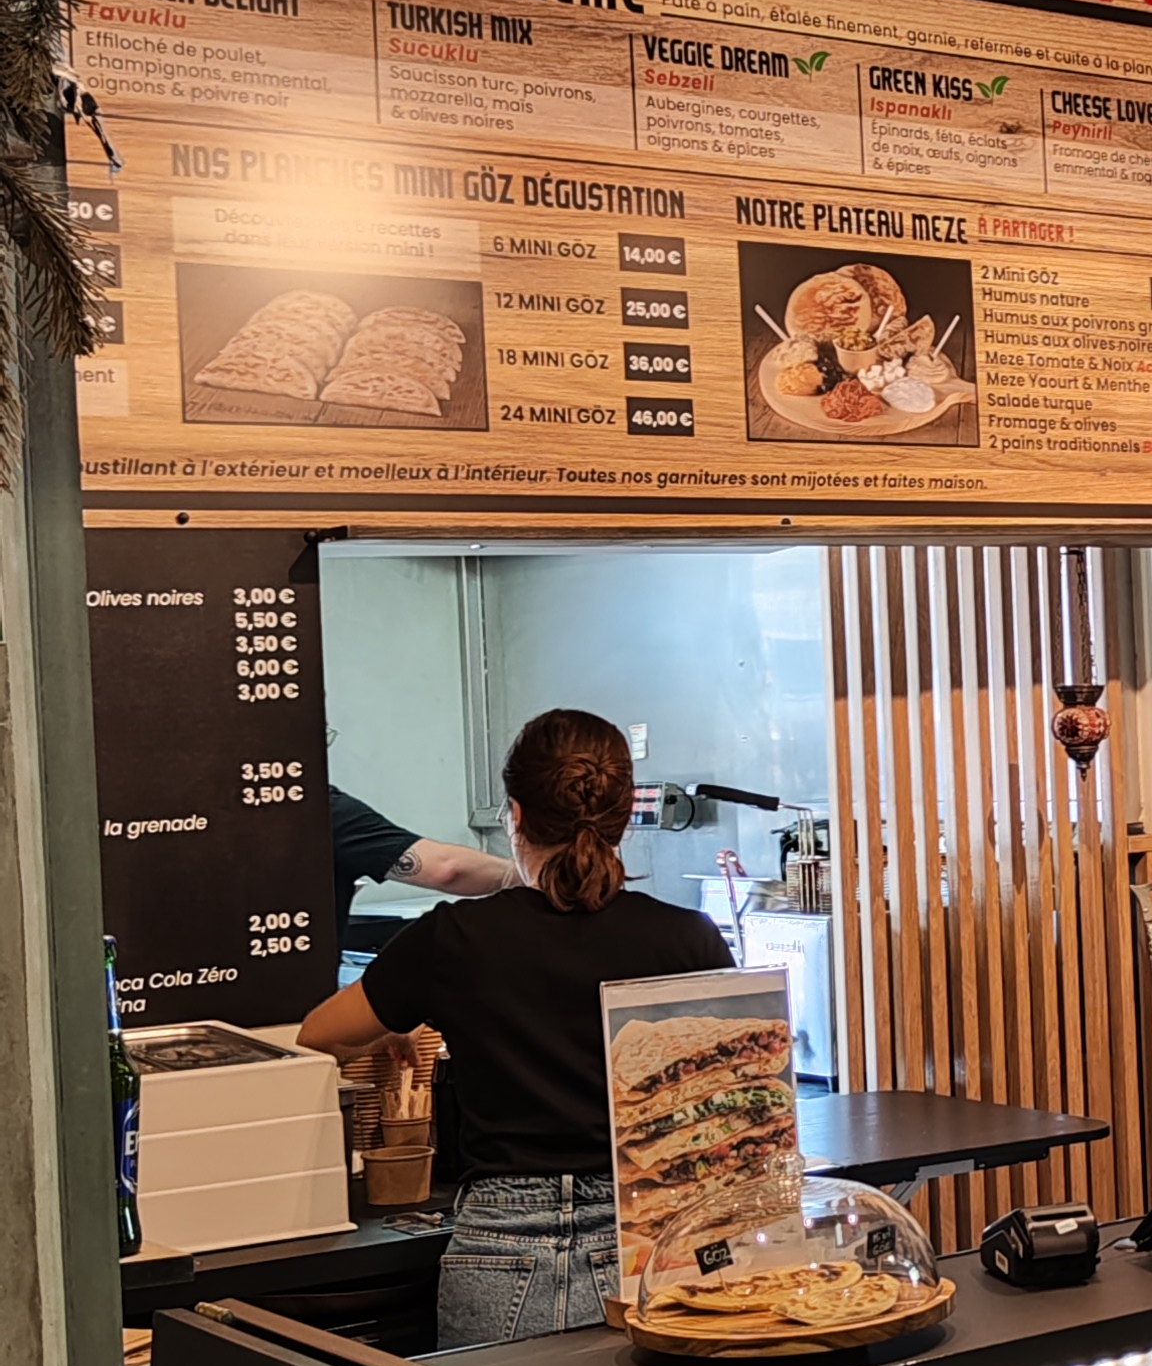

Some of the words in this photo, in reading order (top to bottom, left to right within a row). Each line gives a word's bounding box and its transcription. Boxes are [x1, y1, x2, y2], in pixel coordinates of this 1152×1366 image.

[86, 1, 187, 29] Tavuklu
[387, 1, 483, 40] TURKISH
[491, 15, 533, 45] MIX
[86, 30, 168, 55] Effiloché
[173, 41, 197, 57] de
[723, 2, 765, 23] pain,
[770, 6, 822, 28] étalée
[827, 15, 901, 40] finement,
[965, 35, 1032, 59] refermée
[1054, 48, 1090, 66] cuite
[388, 38, 479, 63] Sucuklu
[643, 34, 715, 69] VEGGIE
[721, 44, 789, 78] DREAM
[88, 76, 166, 96] oignons
[191, 85, 256, 104] poivre
[390, 65, 478, 89] Saucisson
[523, 82, 596, 104] poivrons,
[644, 68, 715, 92] Sebzeli
[869, 65, 927, 96] GREEN
[932, 74, 973, 102] KISS
[646, 96, 736, 120] Aubergines,
[739, 106, 821, 131] courgettes,
[1051, 90, 1112, 120] CHEESE
[409, 107, 458, 126] olives
[463, 113, 514, 131] noires
[1052, 120, 1113, 142] Peynirli
[647, 134, 708, 151] oignons
[728, 140, 776, 159] épices
[968, 132, 1007, 151] éclats
[966, 150, 1018, 168] oignons
[1052, 143, 1108, 165] Fromage
[887, 158, 932, 176] épices
[1054, 162, 1117, 179] emmental
[172, 143, 230, 180] NOS
[397, 163, 454, 200] MINI
[463, 168, 515, 206] GÖZ
[524, 169, 685, 220] DÉGUSTATION
[736, 195, 806, 231] NOTRE
[813, 203, 904, 239] PLATEAU
[912, 214, 968, 244] MEZE
[993, 217, 1065, 242] PARTAGER
[510, 237, 552, 257] MINI
[557, 239, 597, 260] GÖZ
[518, 295, 561, 313] MINI
[565, 293, 606, 315] GÖZ
[982, 288, 1037, 304] Humus
[1040, 293, 1089, 308] nature
[983, 309, 1037, 325] Humus
[1072, 315, 1135, 333] poivrons
[984, 330, 1038, 346] Humus
[1073, 334, 1116, 350] olives
[523, 350, 565, 368] MINI
[570, 350, 610, 371] GÖZ
[985, 351, 1024, 366] Meze
[1027, 353, 1084, 369] Tomate
[986, 372, 1025, 387] Meze
[1028, 375, 1078, 390] Yaourt
[1096, 378, 1150, 393] Menthe
[500, 404, 525, 422] 24
[529, 405, 573, 424] MINI
[577, 404, 616, 426] GÖZ
[987, 393, 1039, 408] Salade
[1043, 396, 1093, 414] turque
[988, 414, 1056, 434] Fromage
[1074, 416, 1116, 432] olives
[1001, 436, 1043, 453] pains
[1047, 437, 1140, 454] traditionnels
[339, 460, 431, 481] moelleux
[556, 467, 617, 484] Toutes
[621, 471, 653, 485] nos
[657, 469, 747, 489] garnitures
[751, 471, 787, 487] sont
[791, 472, 859, 492] mijotées
[881, 472, 925, 490] faites
[928, 475, 988, 491] maison.
[86, 588, 142, 608] Olives
[146, 588, 204, 608] noires
[127, 813, 208, 839] grenade
[148, 970, 194, 989] Cola
[197, 965, 238, 984] Zéro
